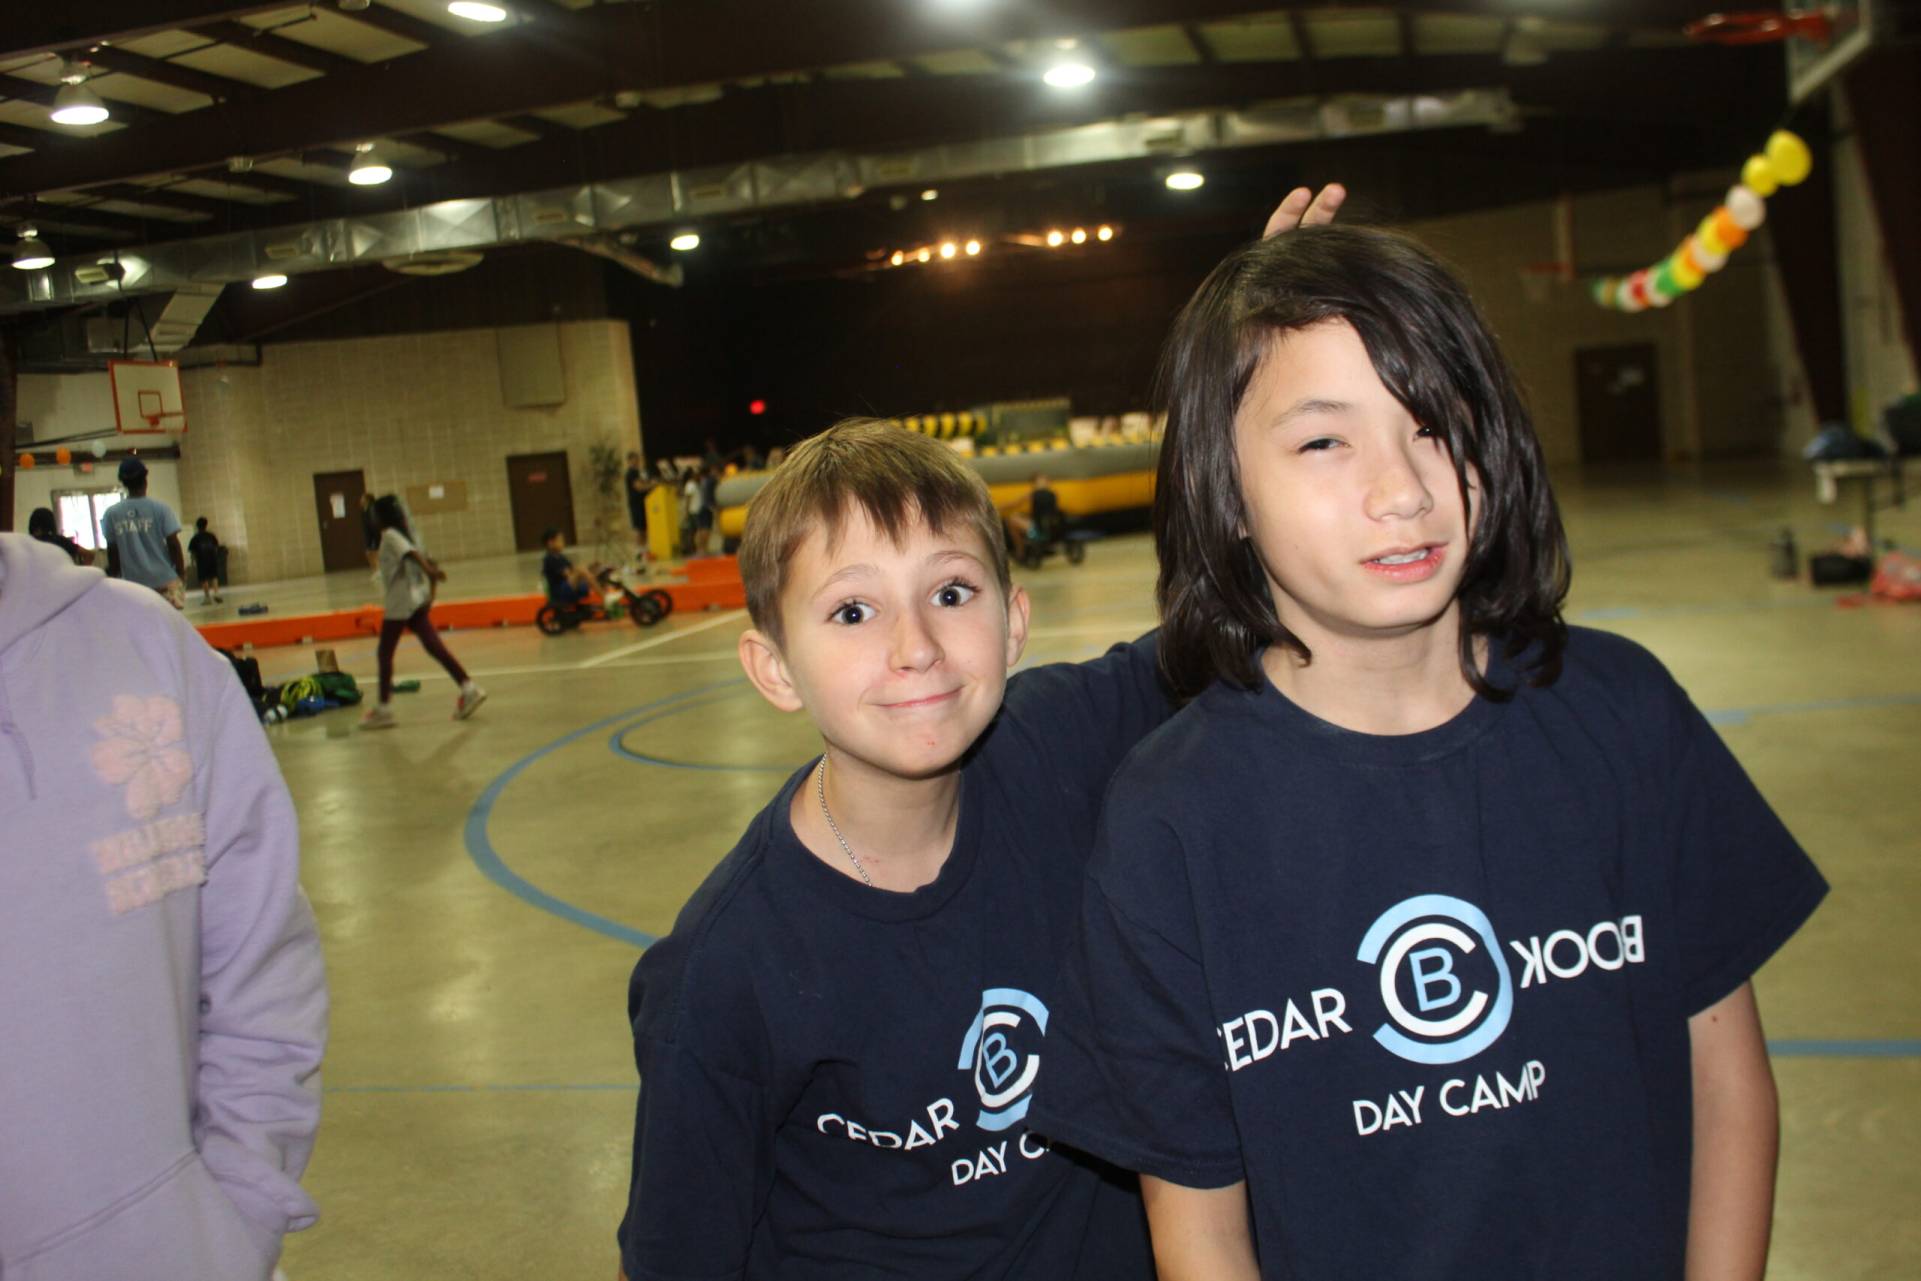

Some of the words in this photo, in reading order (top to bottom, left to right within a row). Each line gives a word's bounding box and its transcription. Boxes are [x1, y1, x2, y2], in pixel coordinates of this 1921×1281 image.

[115, 517, 154, 536] STAFF
[1216, 988, 1353, 1072] EDAR
[817, 1097, 960, 1151] CEDAR
[1352, 1085, 1425, 1136] DAY
[1439, 1060, 1546, 1117] CAMP
[951, 1140, 1008, 1186] DAY
